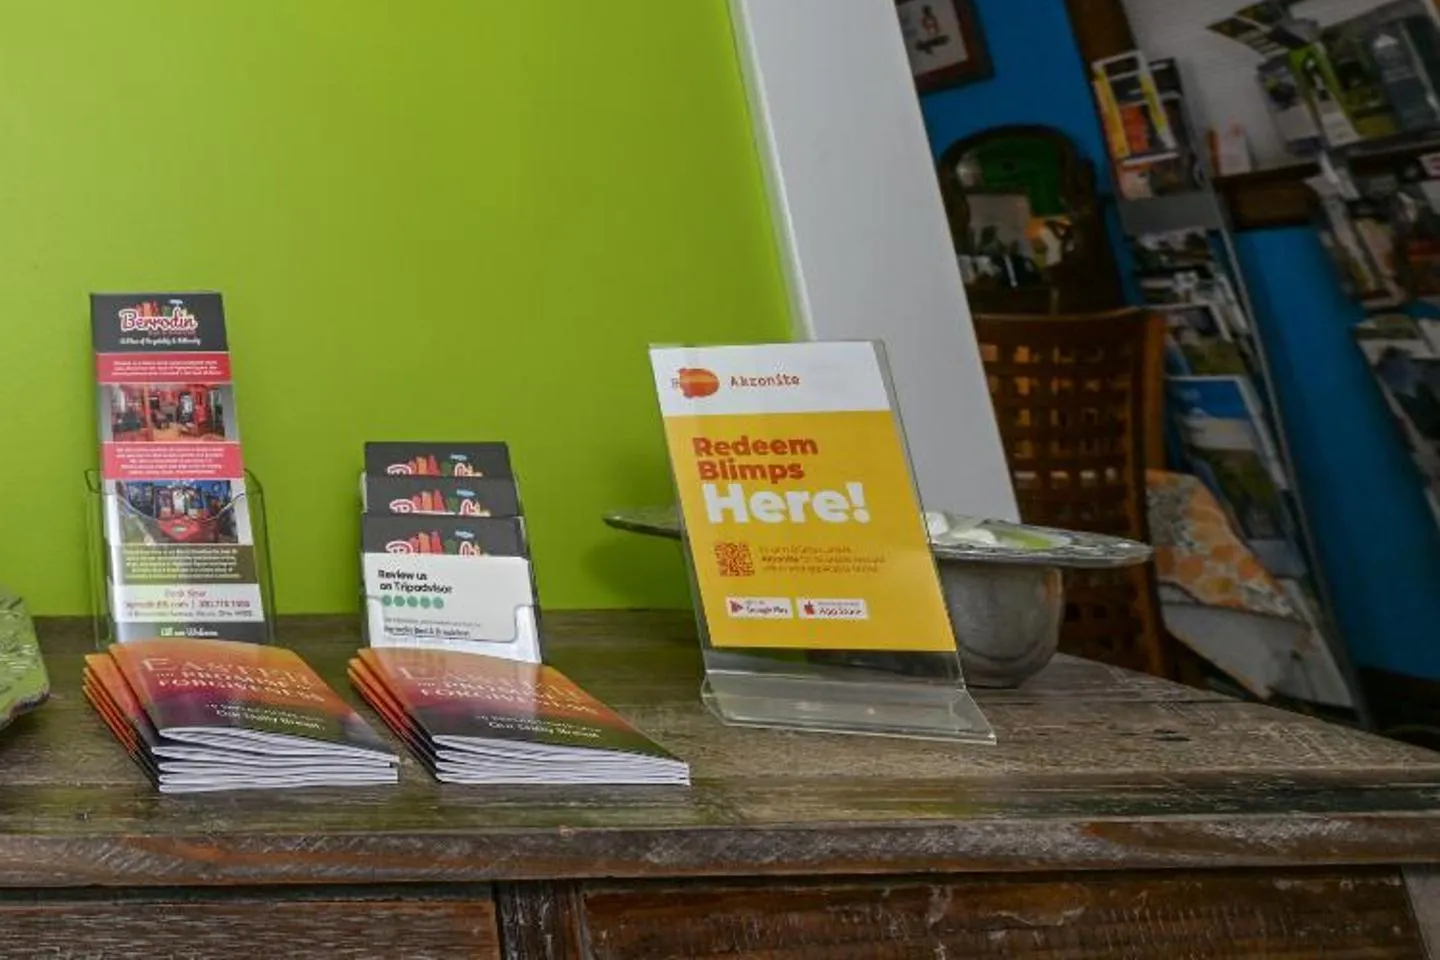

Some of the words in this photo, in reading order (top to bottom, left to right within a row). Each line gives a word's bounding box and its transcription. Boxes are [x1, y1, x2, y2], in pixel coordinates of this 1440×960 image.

[118, 306, 199, 333] Berrodin
[692, 434, 819, 457] Redeem
[697, 457, 806, 484] Blimps
[702, 481, 871, 524] Here!
[377, 569, 415, 581] Review
[416, 571, 428, 581] us
[379, 582, 393, 591] on
[394, 581, 454, 595] Tripadvisor
